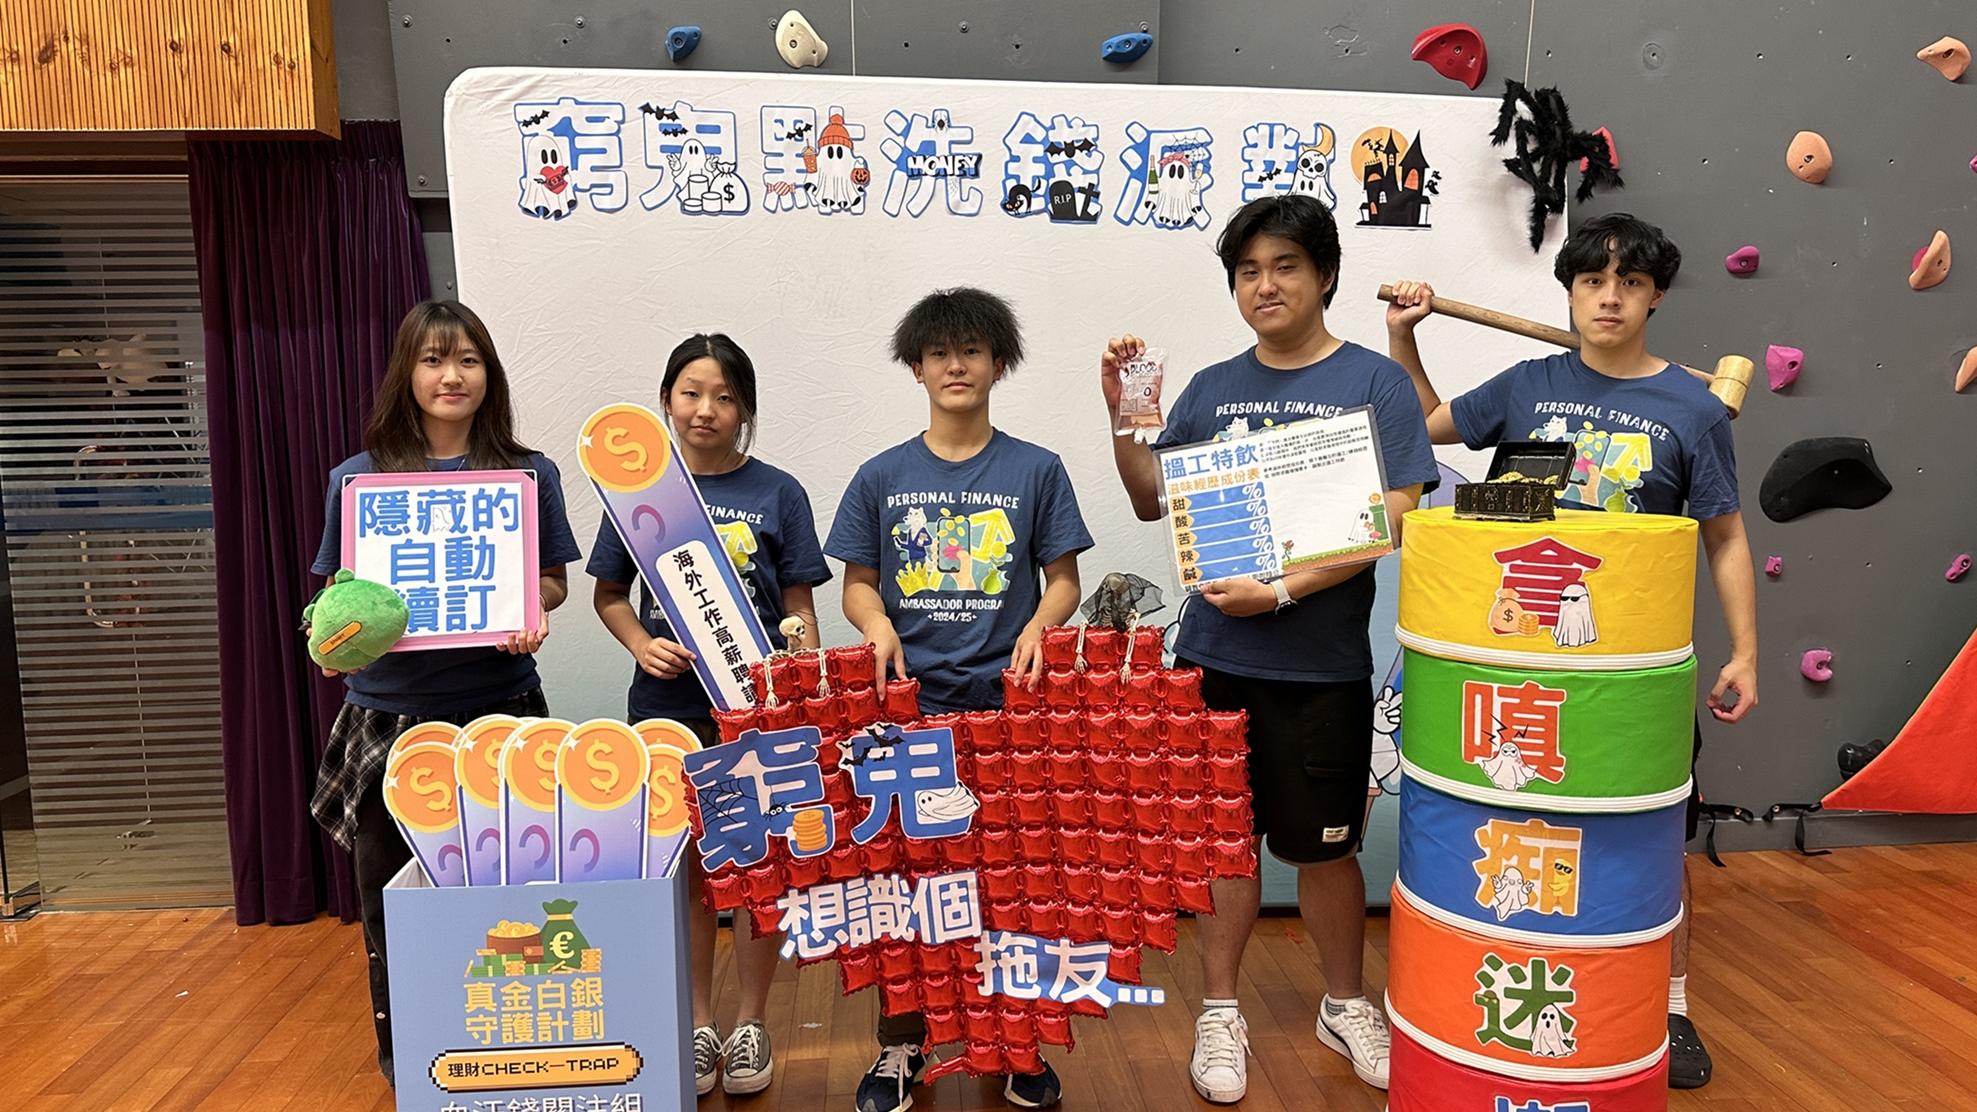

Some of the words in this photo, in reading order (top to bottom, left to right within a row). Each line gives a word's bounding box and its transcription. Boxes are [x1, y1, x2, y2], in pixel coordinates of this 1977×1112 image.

[907, 153, 980, 177] MONEY
[1215, 401, 1280, 418] PERSONAL
[1284, 400, 1344, 419] FINANCE
[1534, 401, 1603, 419] PERSONAL
[1607, 409, 1670, 441] FINANCE
[358, 487, 520, 537] 隱藏的
[887, 491, 956, 509] PERSONAL
[960, 492, 1020, 509] FINANCE
[1172, 497, 1186, 511] 甜
[1242, 482, 1262, 500] %
[1174, 516, 1189, 529] 酸
[1246, 500, 1267, 517] %
[1177, 533, 1191, 546] 苦
[1249, 518, 1270, 535] %
[1252, 536, 1273, 554] %
[390, 535, 496, 585] 自動
[1255, 553, 1276, 572] %
[396, 584, 496, 634] 續訂
[899, 598, 963, 610] AMBASSADOR
[932, 611, 972, 622] 2024/25
[1464, 681, 1566, 787] 嗔
[683, 724, 979, 871] 窮鬼
[778, 866, 981, 958] 想識個
[463, 977, 604, 1013] 真金白銀
[1475, 953, 1576, 1056] 迷
[465, 1009, 605, 1045] 守護計劃
